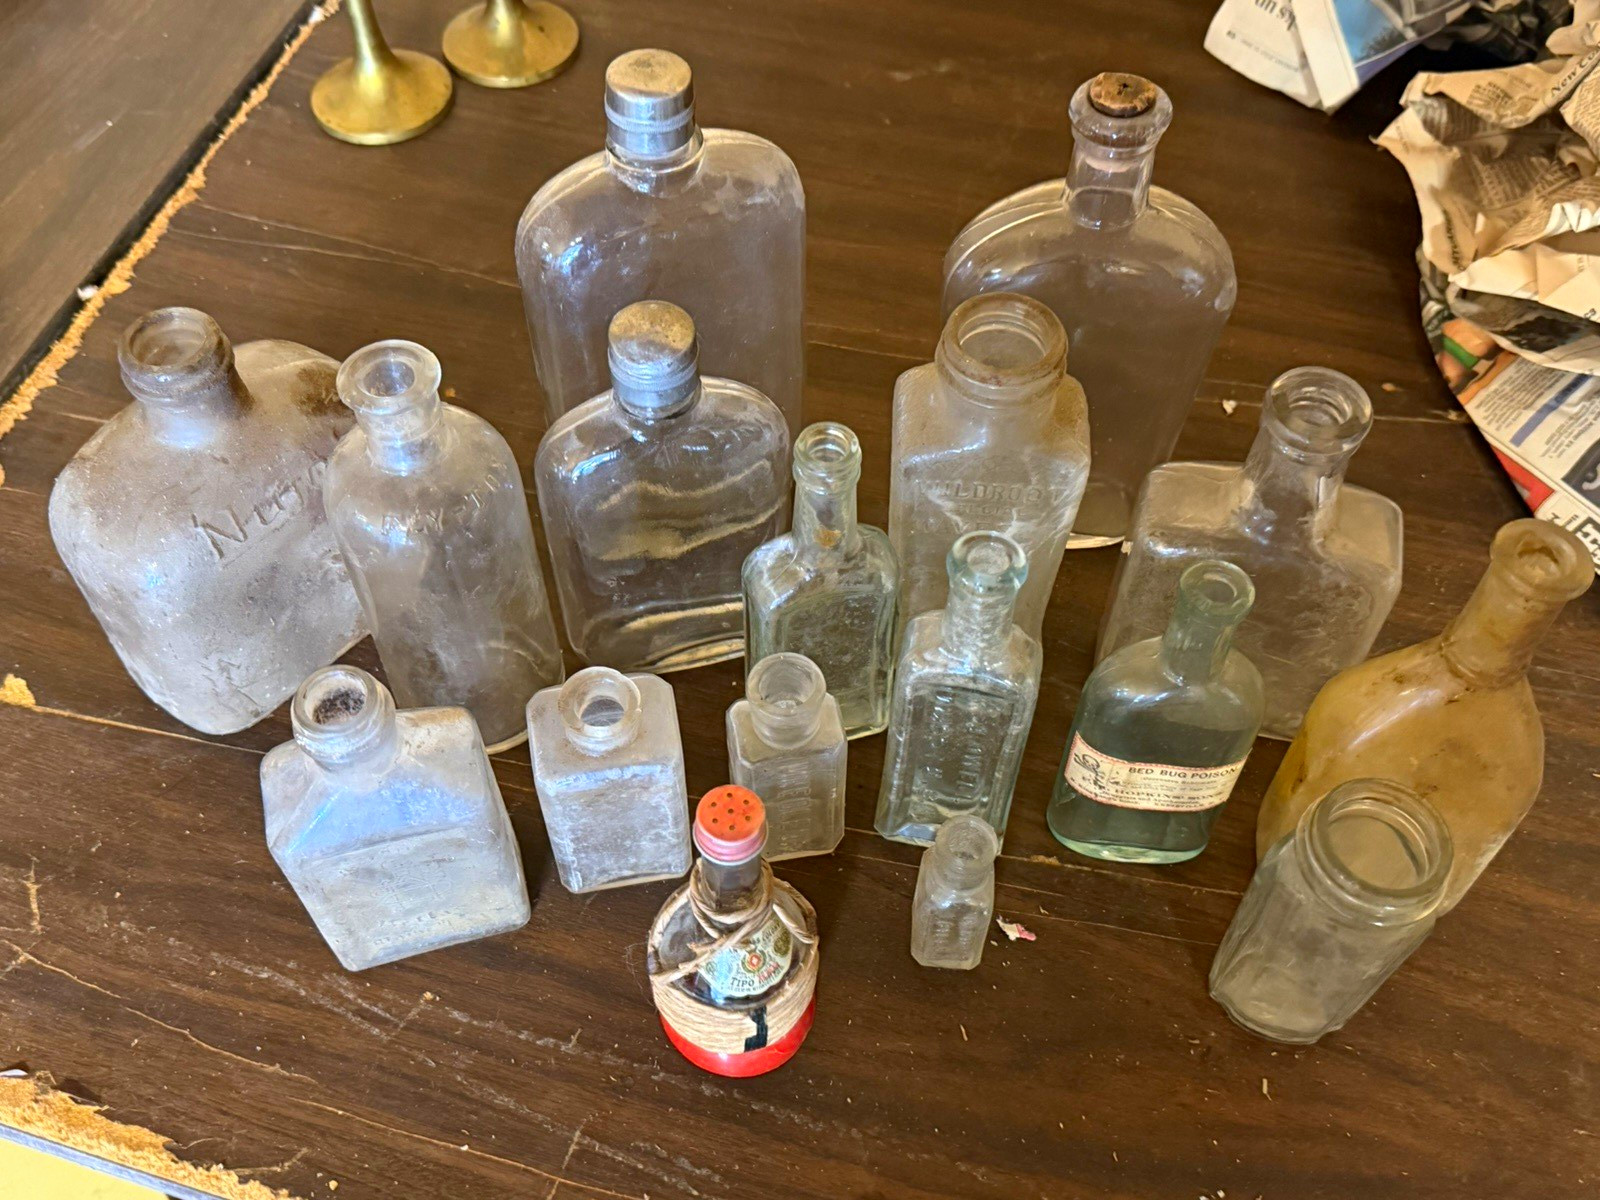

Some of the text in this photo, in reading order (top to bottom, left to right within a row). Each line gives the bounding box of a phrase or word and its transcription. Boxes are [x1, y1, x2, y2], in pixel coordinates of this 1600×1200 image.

[1550, 67, 1577, 98] New
[1128, 766, 1239, 779] BED BUG POISON
[731, 976, 755, 987] TIPO
